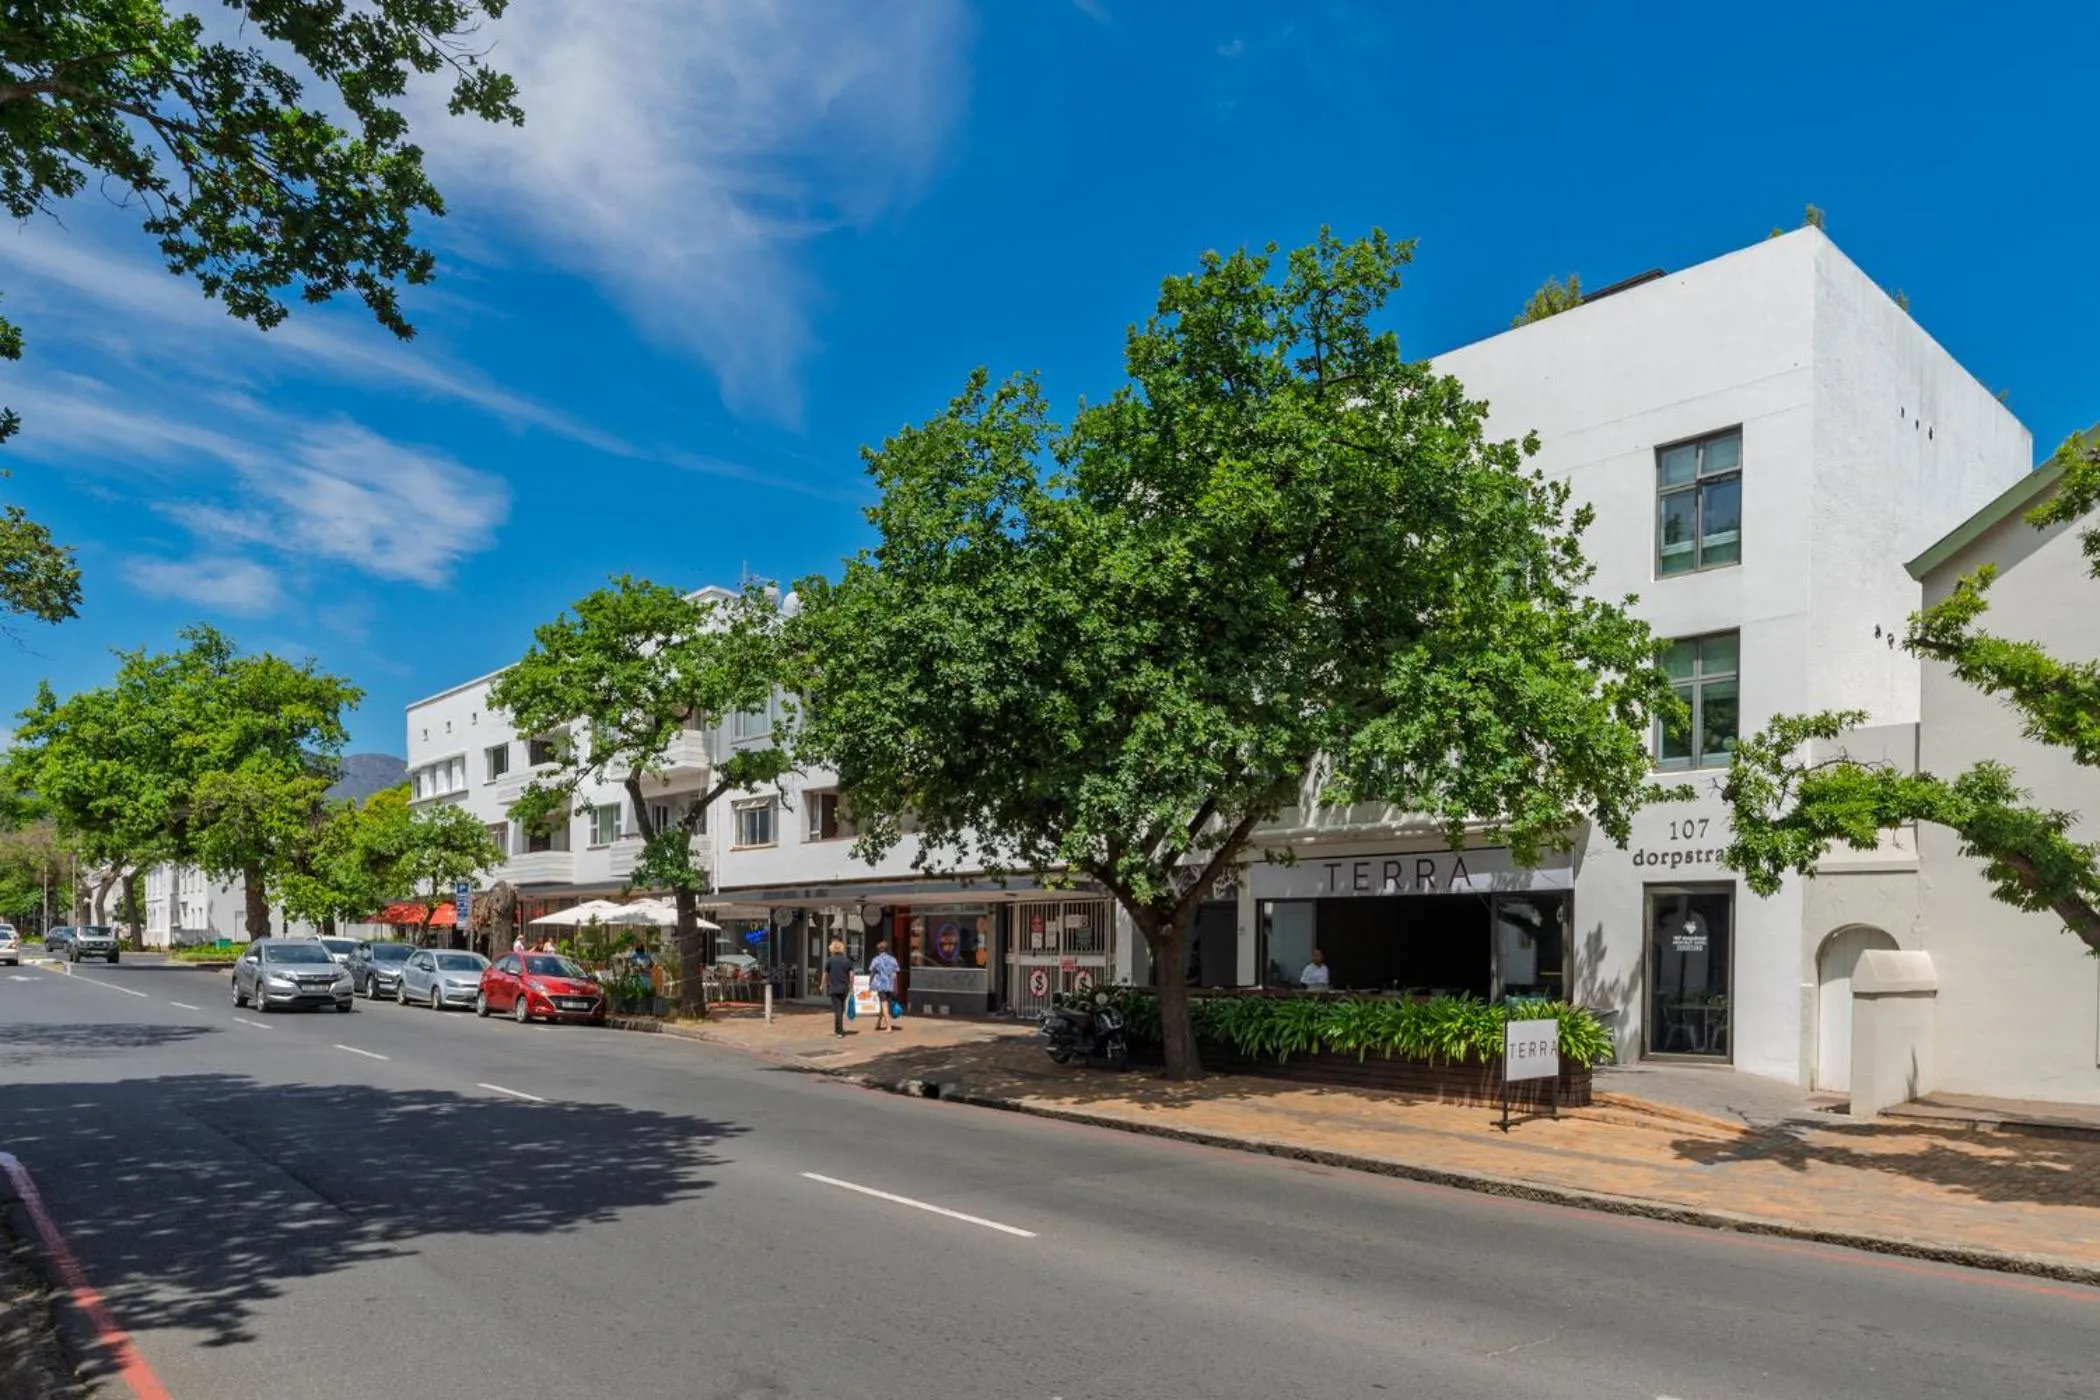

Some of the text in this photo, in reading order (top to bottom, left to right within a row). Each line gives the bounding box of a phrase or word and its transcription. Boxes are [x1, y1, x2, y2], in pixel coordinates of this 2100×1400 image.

[1669, 818, 1710, 840] 107
[1323, 856, 1472, 892] TERRA
[1509, 1039, 1559, 1059] TERRA
